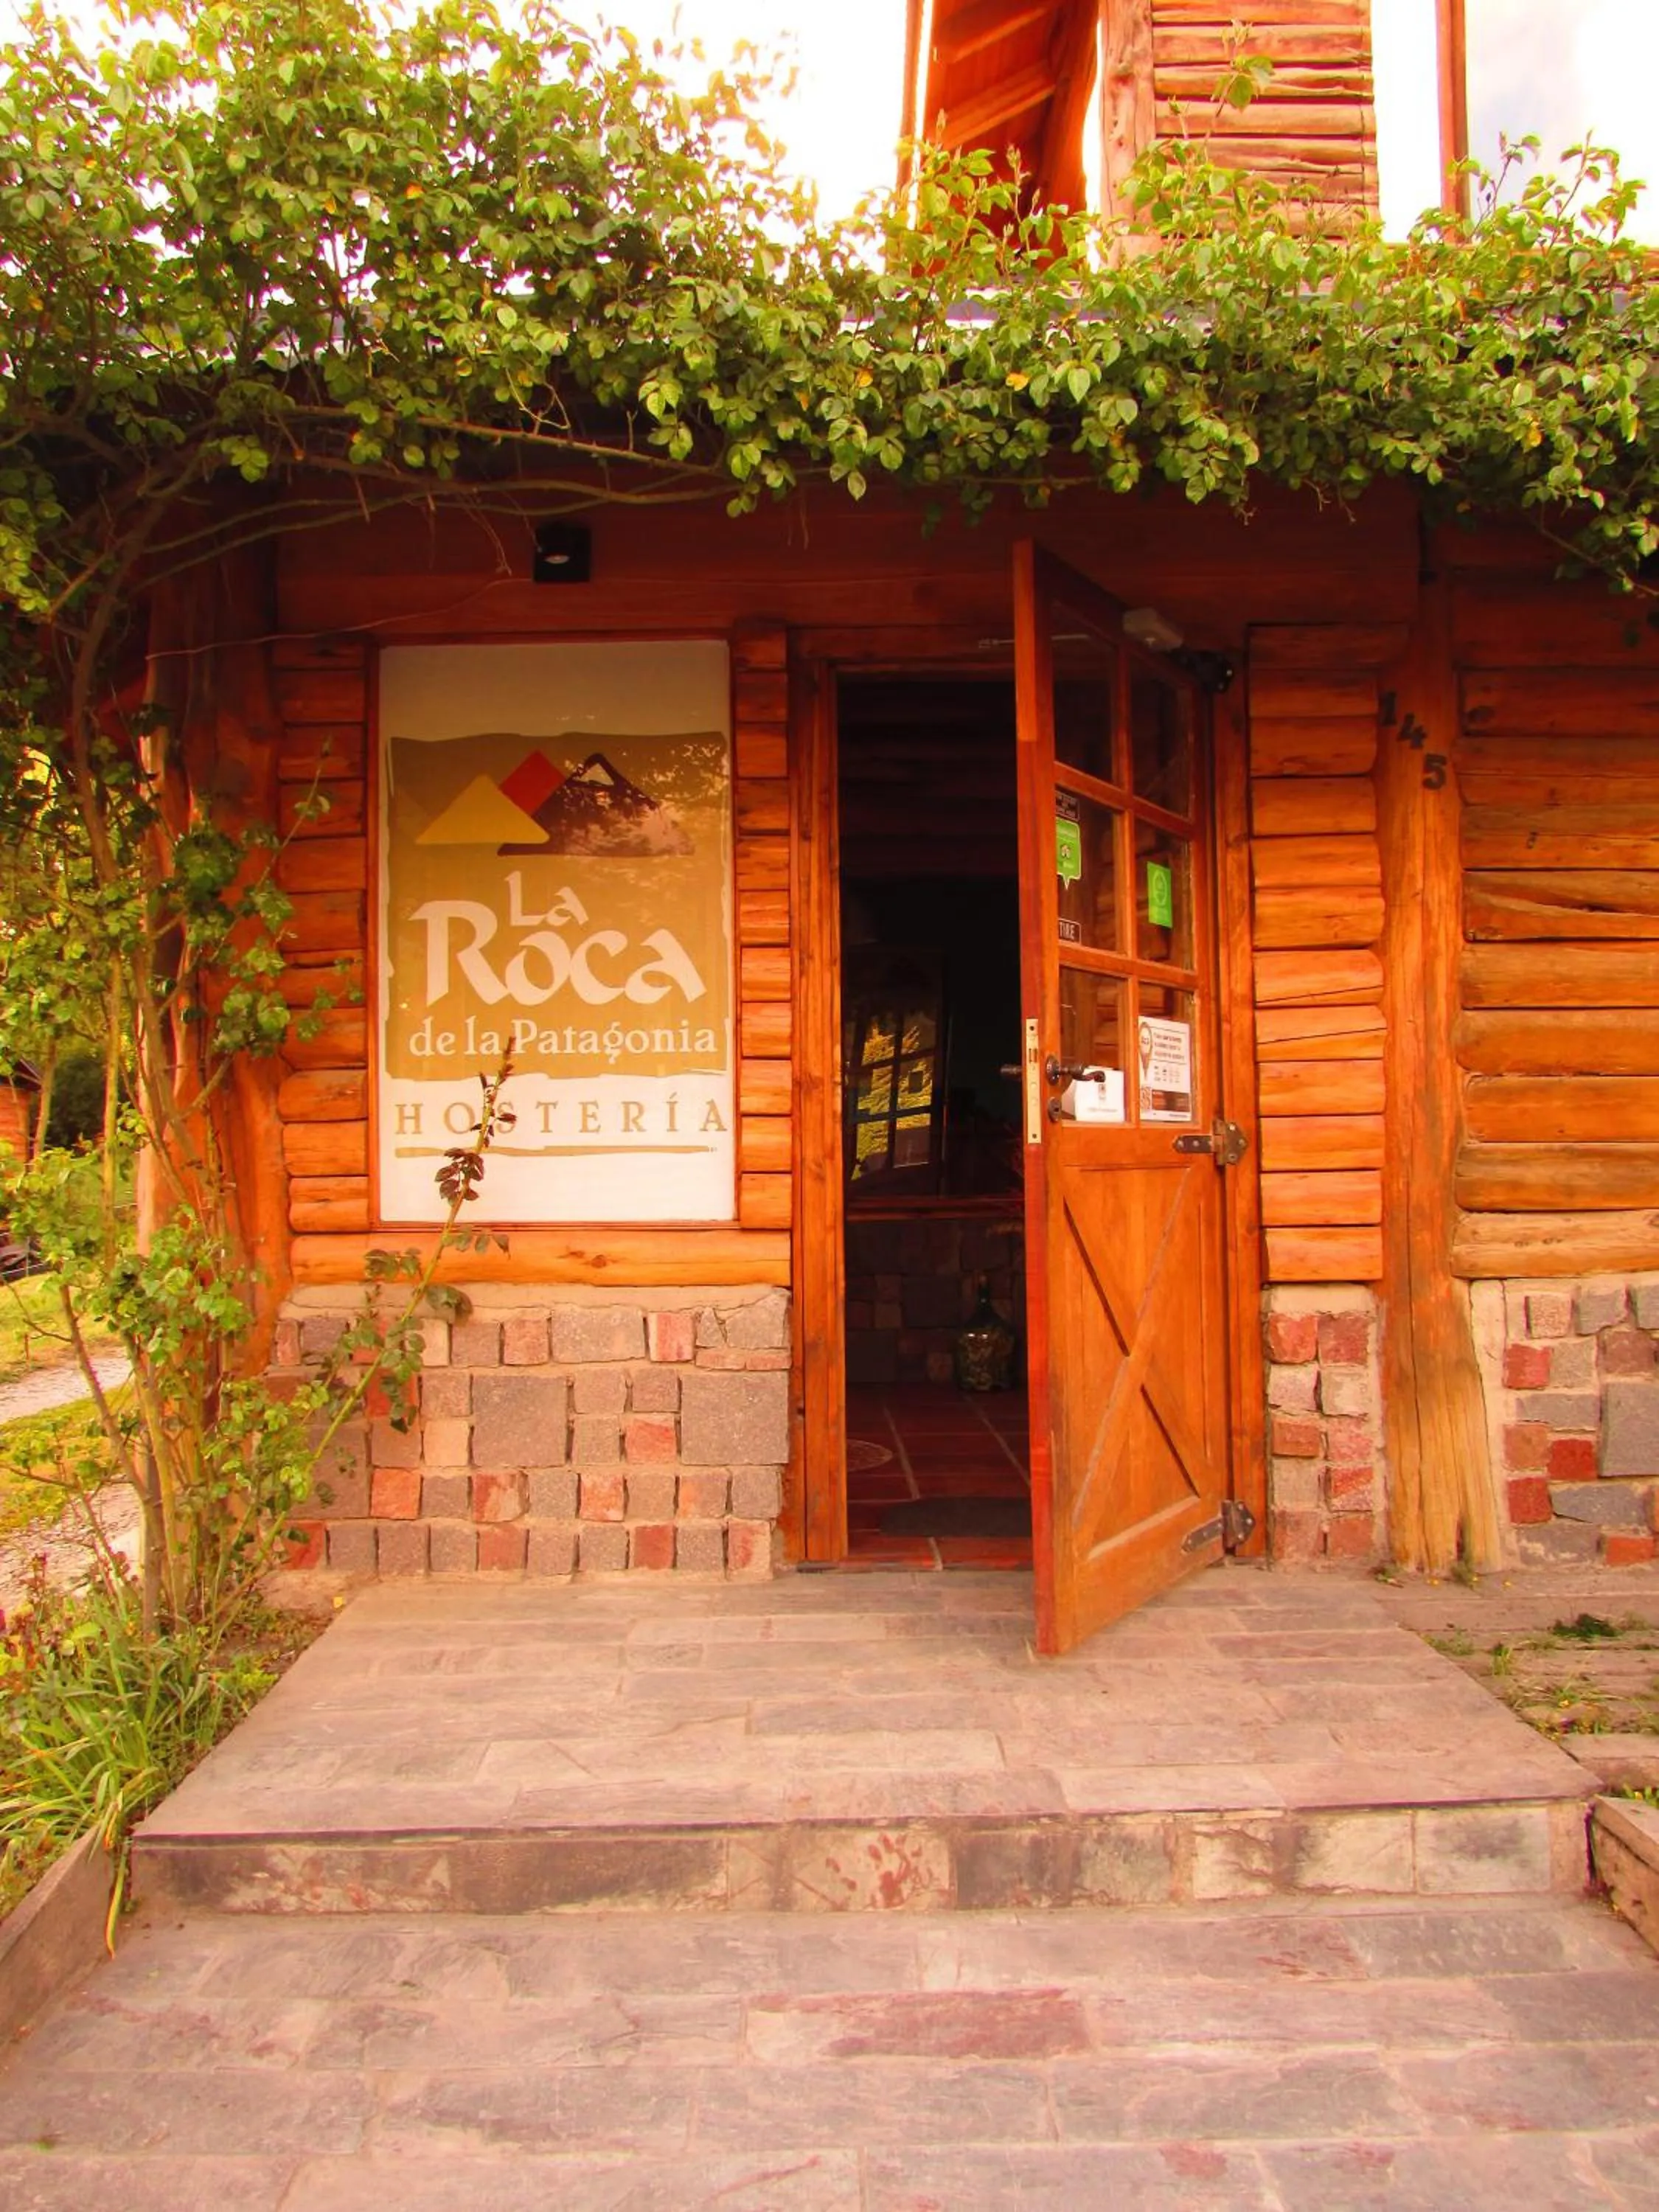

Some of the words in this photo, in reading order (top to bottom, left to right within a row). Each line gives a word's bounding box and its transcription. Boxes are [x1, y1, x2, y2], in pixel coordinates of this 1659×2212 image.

[1378, 690, 1447, 790] 145
[409, 1009, 456, 1057] de
[465, 1015, 503, 1056] la
[511, 1018, 717, 1065] Patagonia
[394, 1092, 728, 1135] HOSTERÍA
